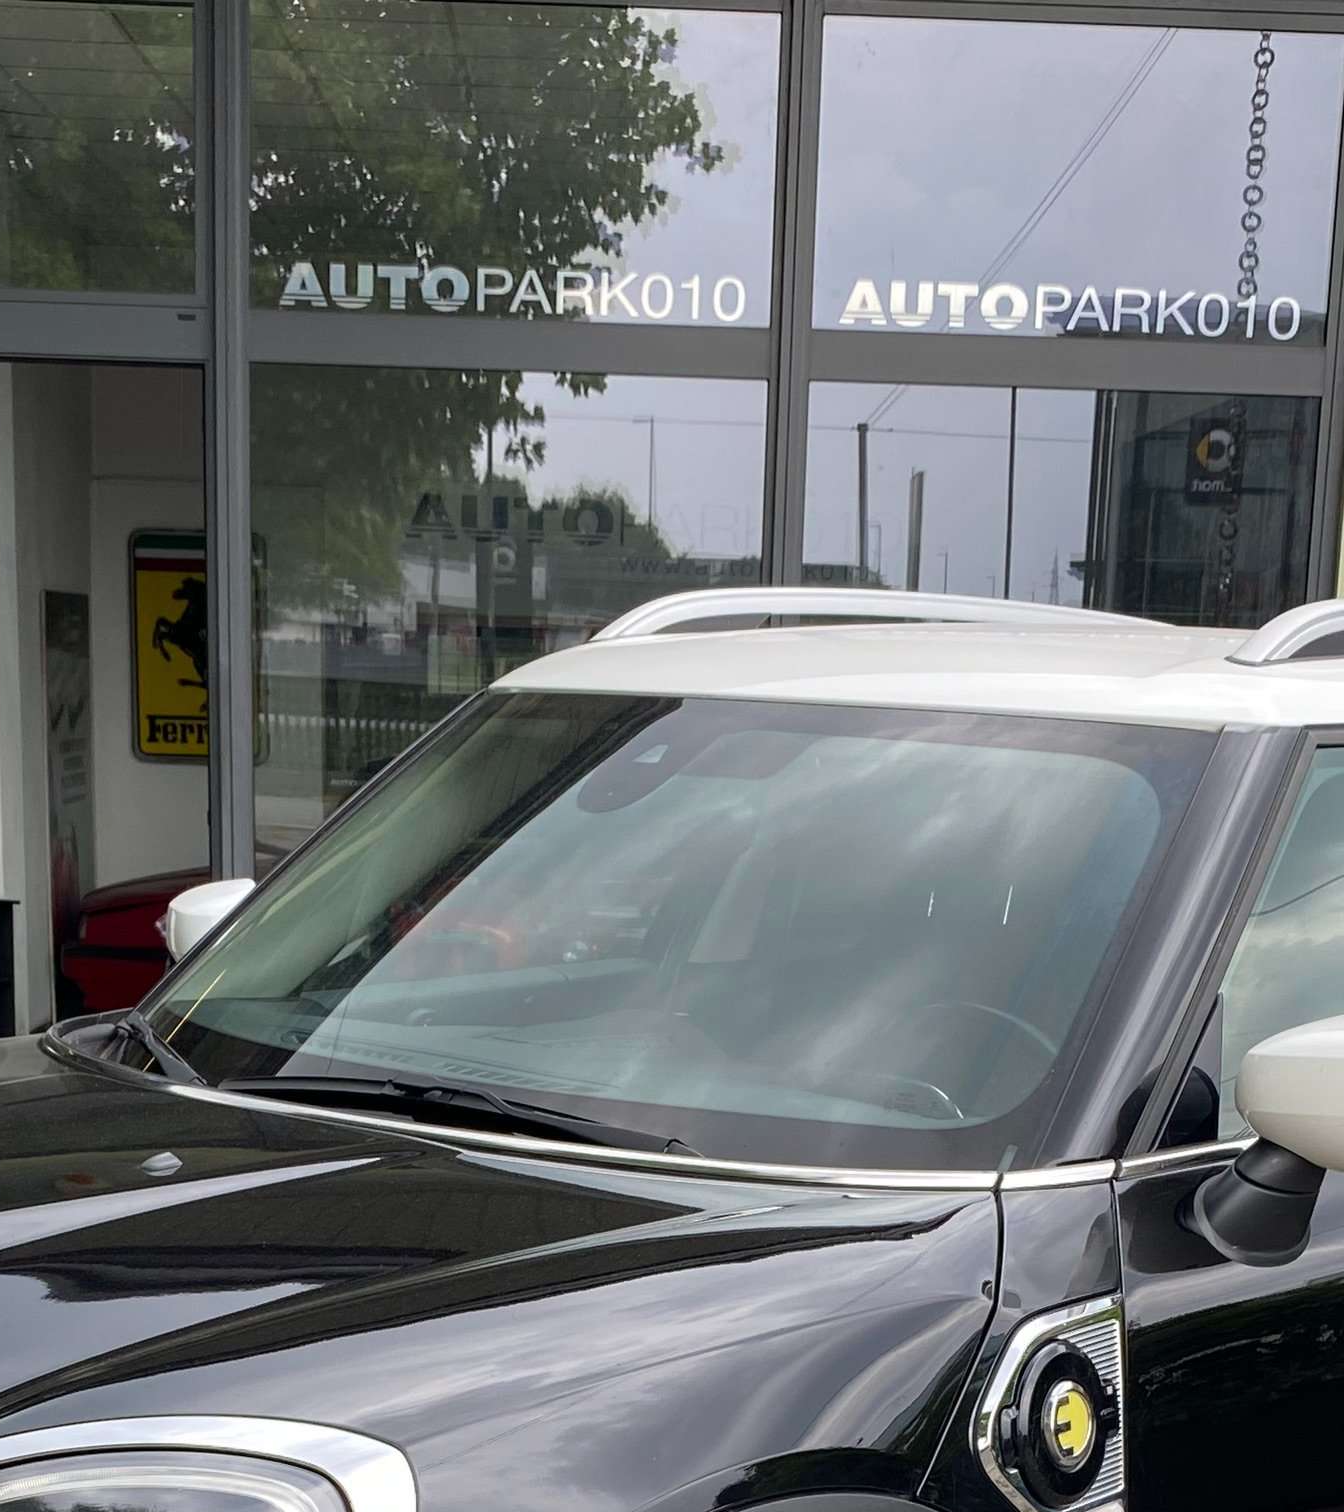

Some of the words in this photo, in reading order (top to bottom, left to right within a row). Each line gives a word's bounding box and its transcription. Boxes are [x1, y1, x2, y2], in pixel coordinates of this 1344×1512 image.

[279, 262, 746, 322] AUTOPARK010
[838, 279, 1301, 341] AUTOPARK010
[146, 714, 209, 745] Ferr
